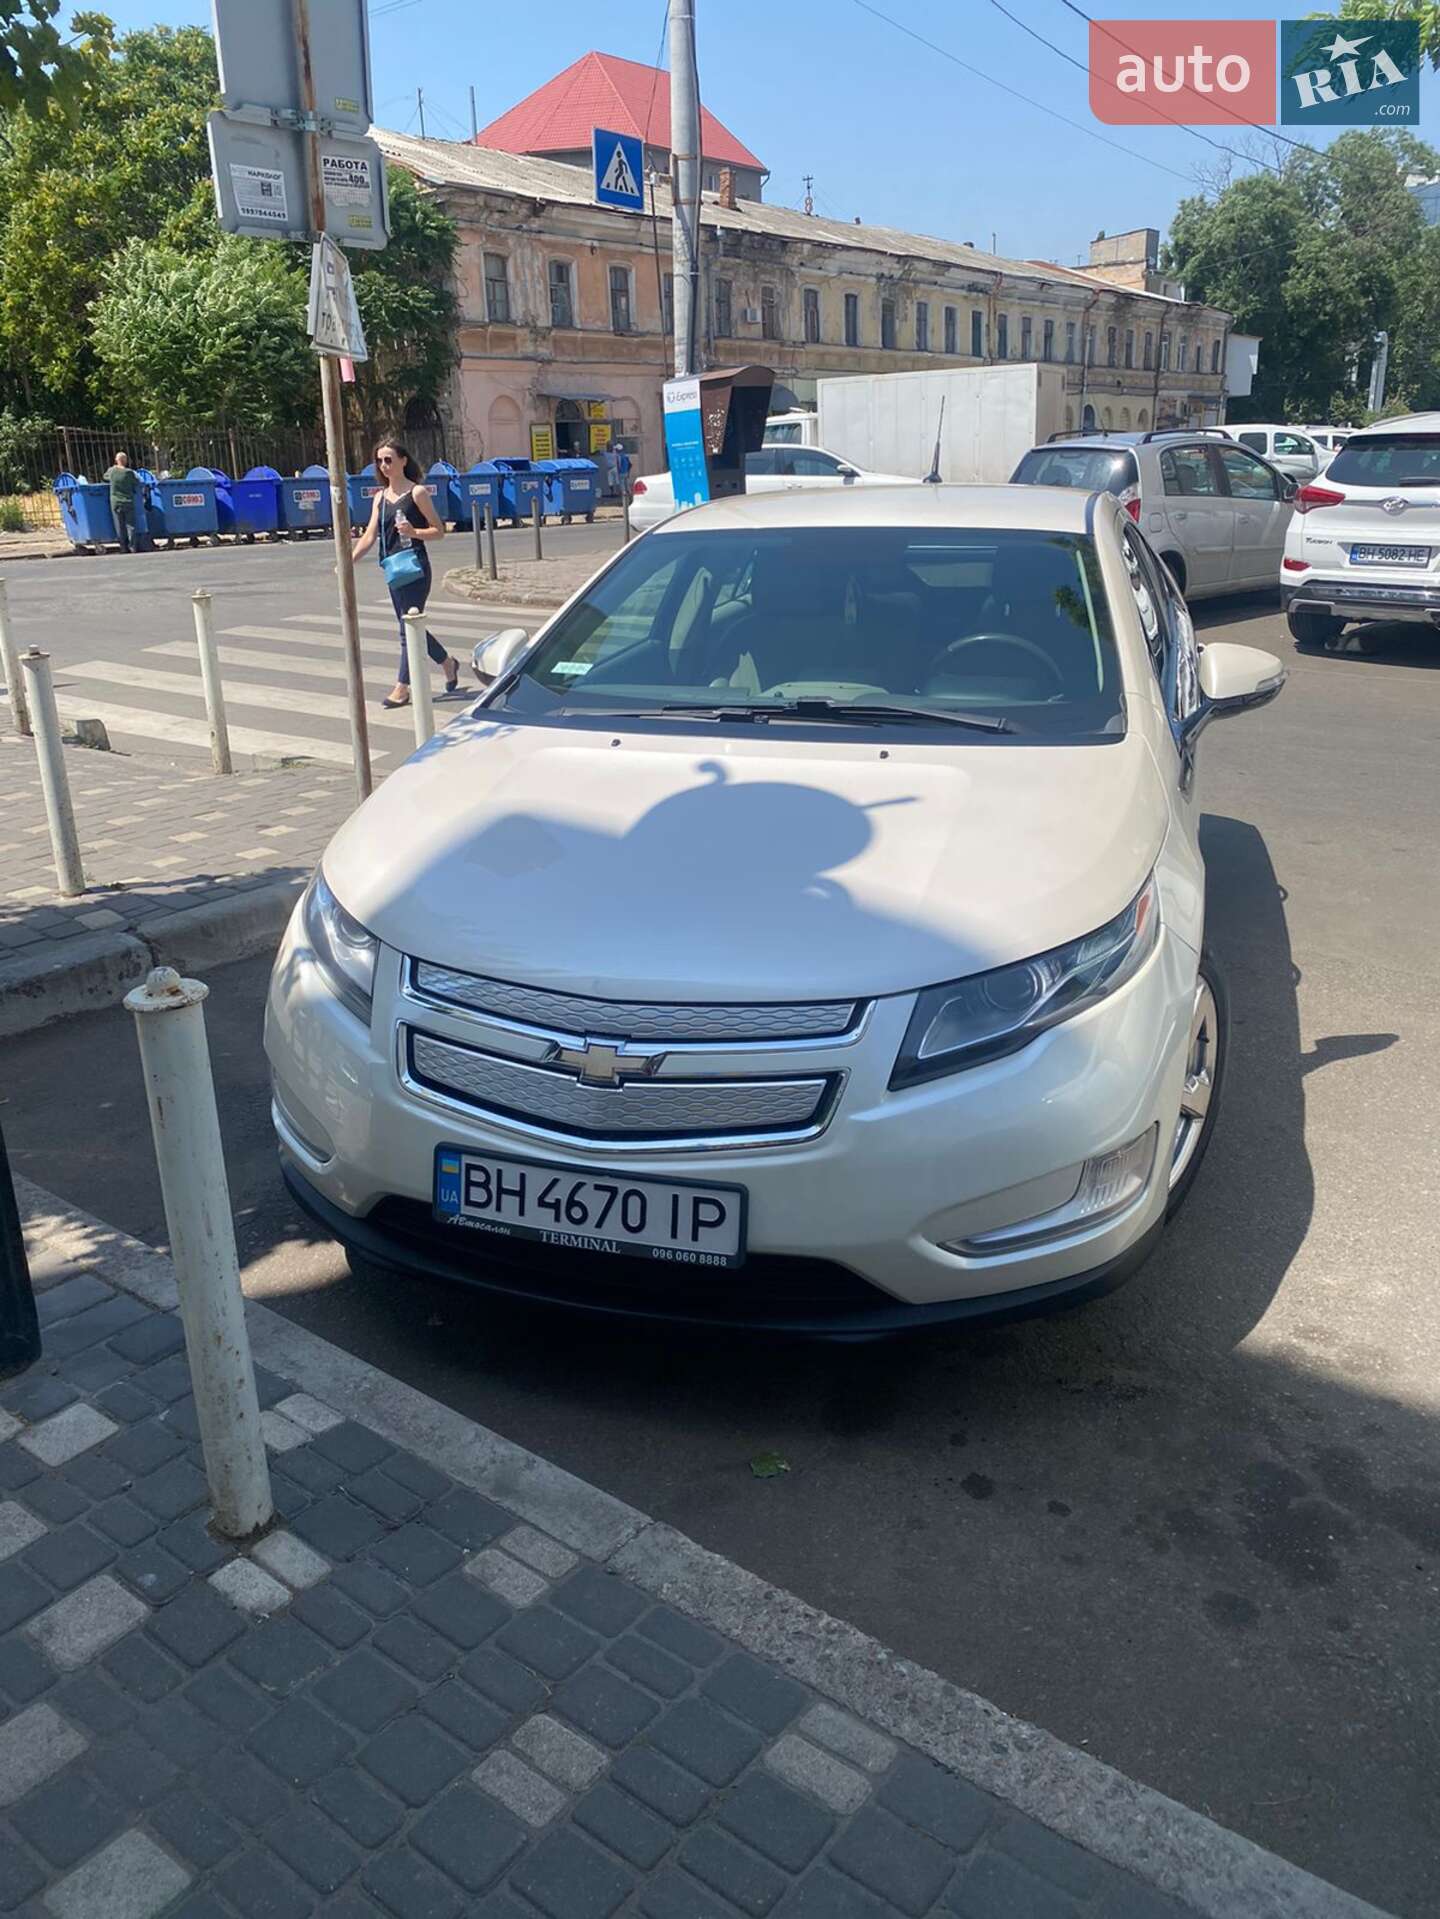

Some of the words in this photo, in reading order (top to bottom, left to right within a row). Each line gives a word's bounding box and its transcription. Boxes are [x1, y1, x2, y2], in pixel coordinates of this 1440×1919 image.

[323, 158, 368, 171] РАБОТА
[1377, 547, 1406, 561] 5082
[1407, 549, 1425, 562] HE
[441, 1188, 459, 1204] UA
[464, 1162, 527, 1218] BH
[536, 1176, 648, 1235] 4670
[670, 1193, 727, 1243] IP
[539, 1230, 621, 1254] TERMINAL
[652, 1247, 673, 1260] 096
[675, 1250, 697, 1263] 060
[699, 1253, 728, 1267] 8888
